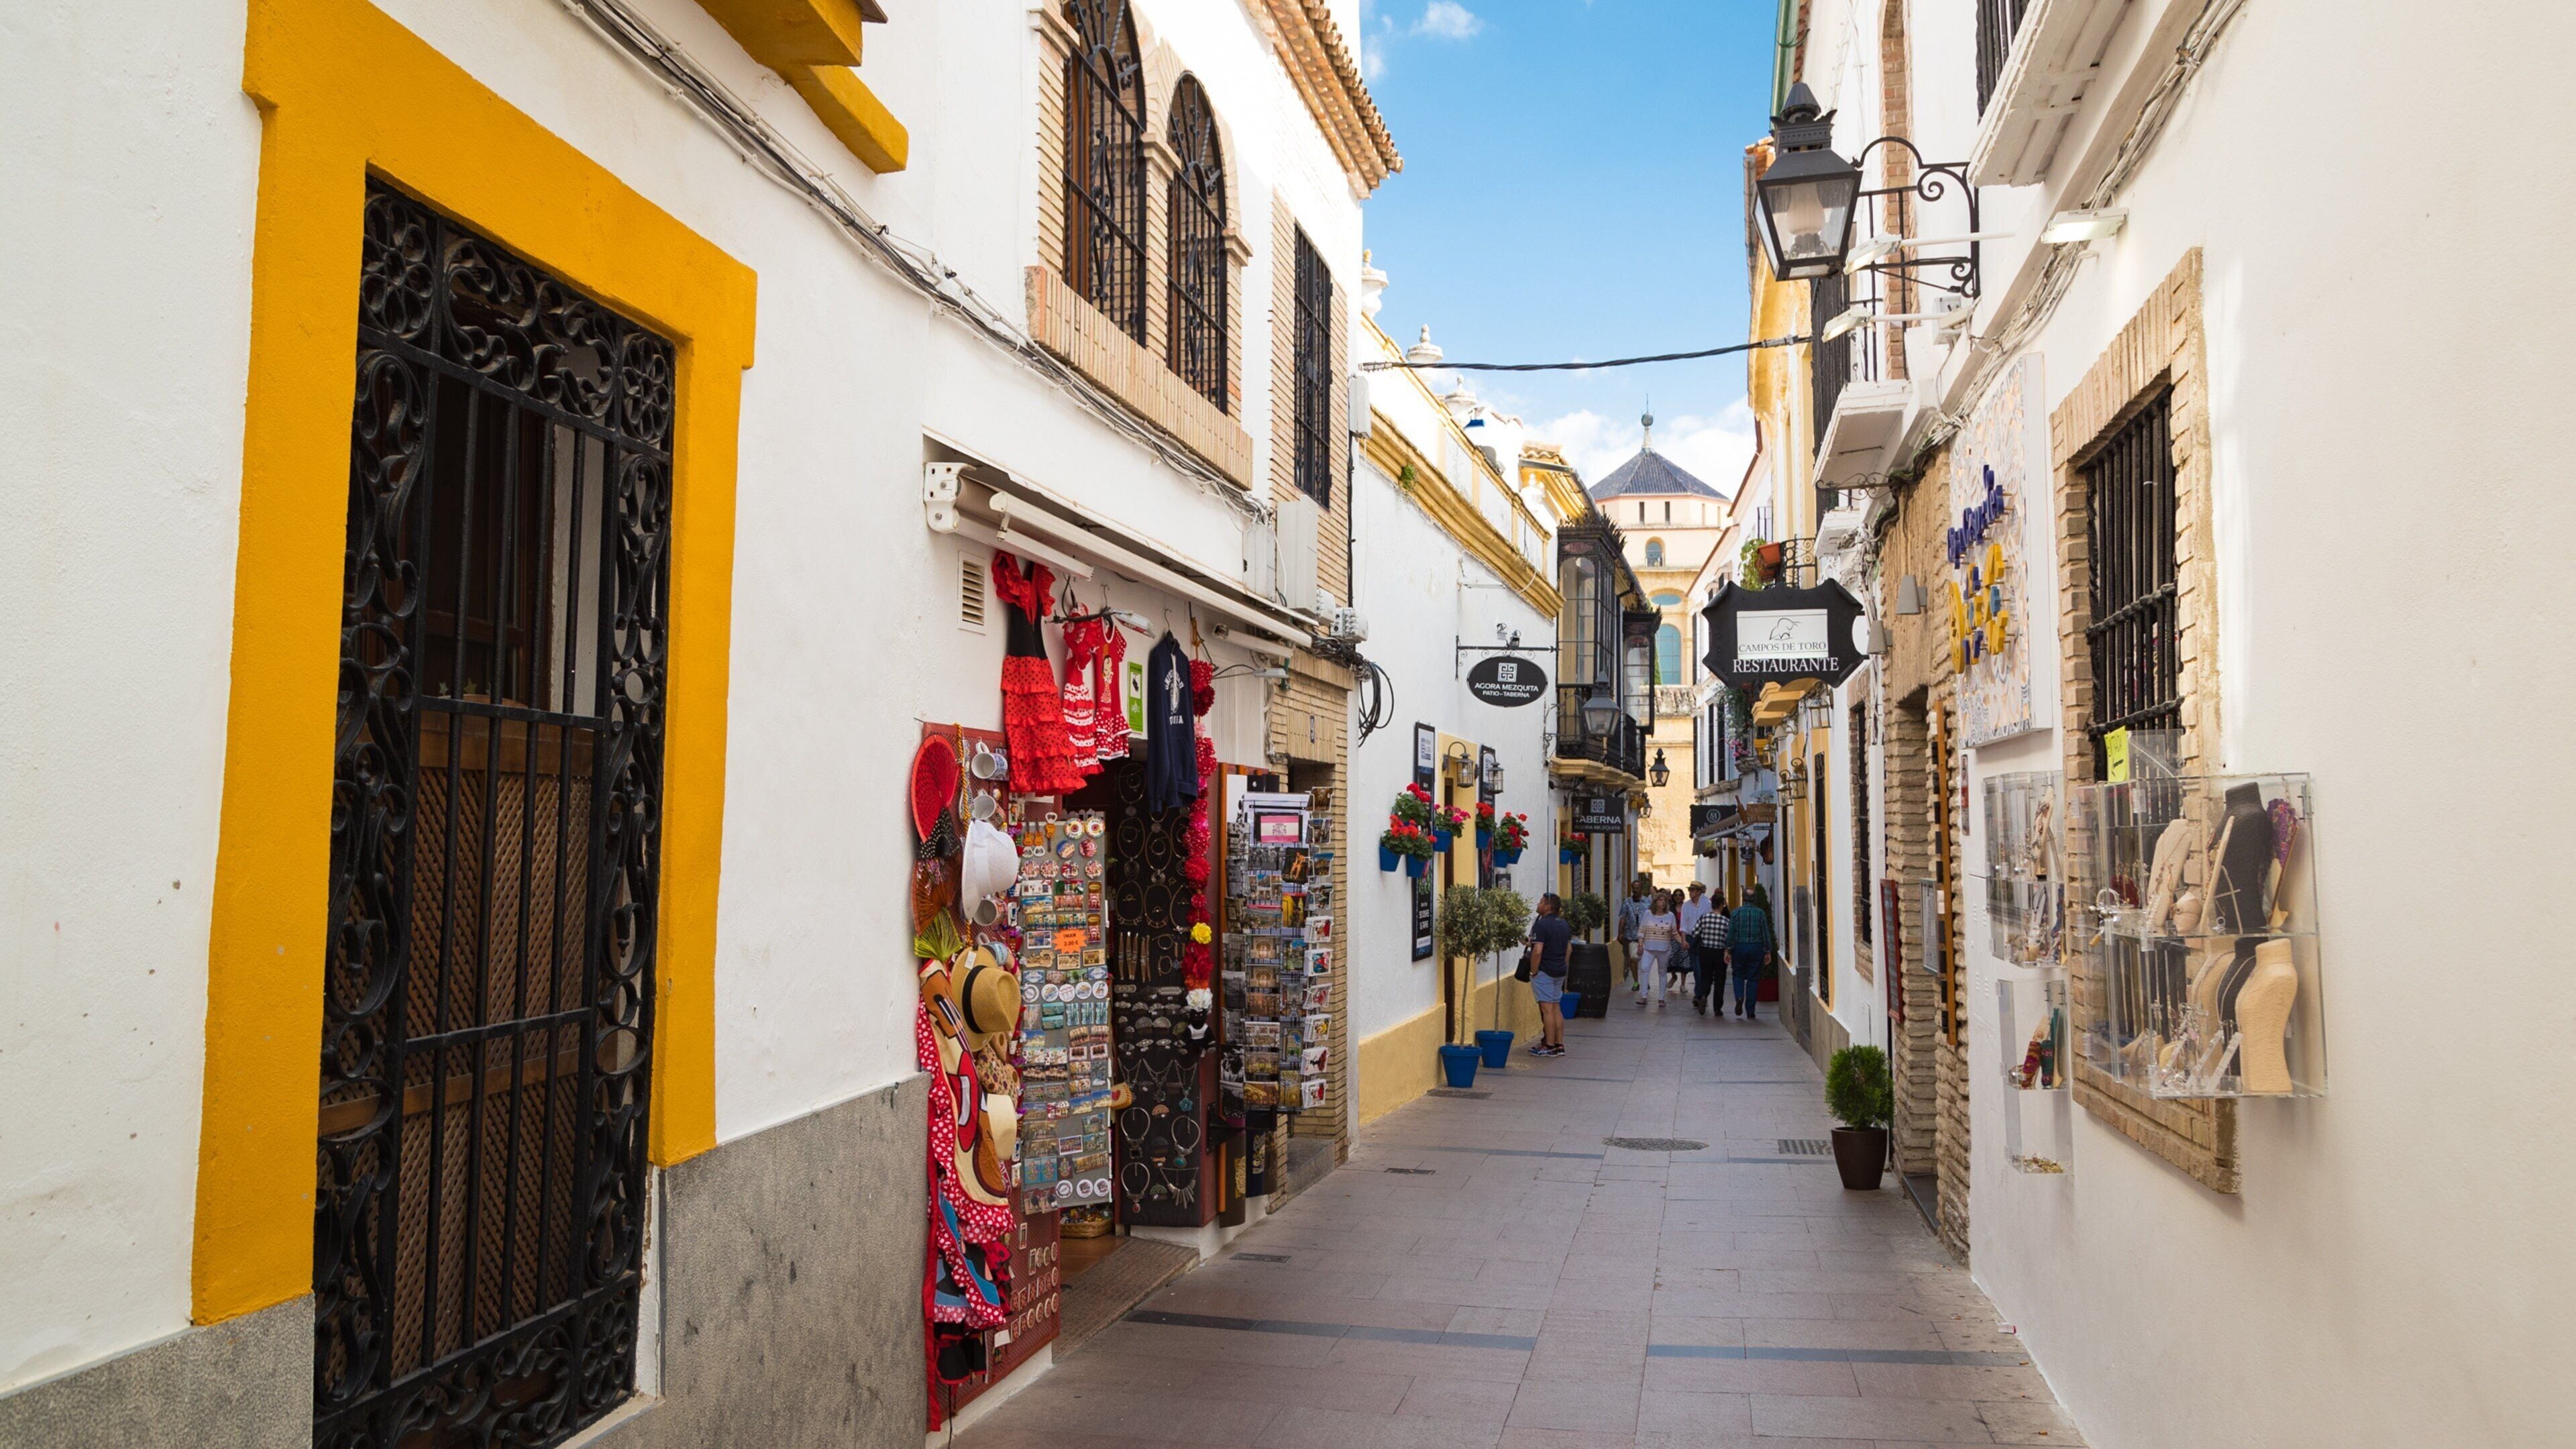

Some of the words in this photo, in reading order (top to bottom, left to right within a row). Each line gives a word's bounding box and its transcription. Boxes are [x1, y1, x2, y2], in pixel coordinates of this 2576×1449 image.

[1738, 643, 1779, 652] CAMPOS
[1782, 642, 1795, 651] DE
[1798, 641, 1827, 651] TORO
[1733, 657, 1839, 672] RESTAURANTE
[1474, 682, 1501, 690] AGORA
[1502, 684, 1539, 692] MEZQUITA
[1576, 815, 1621, 824] ABERNA
